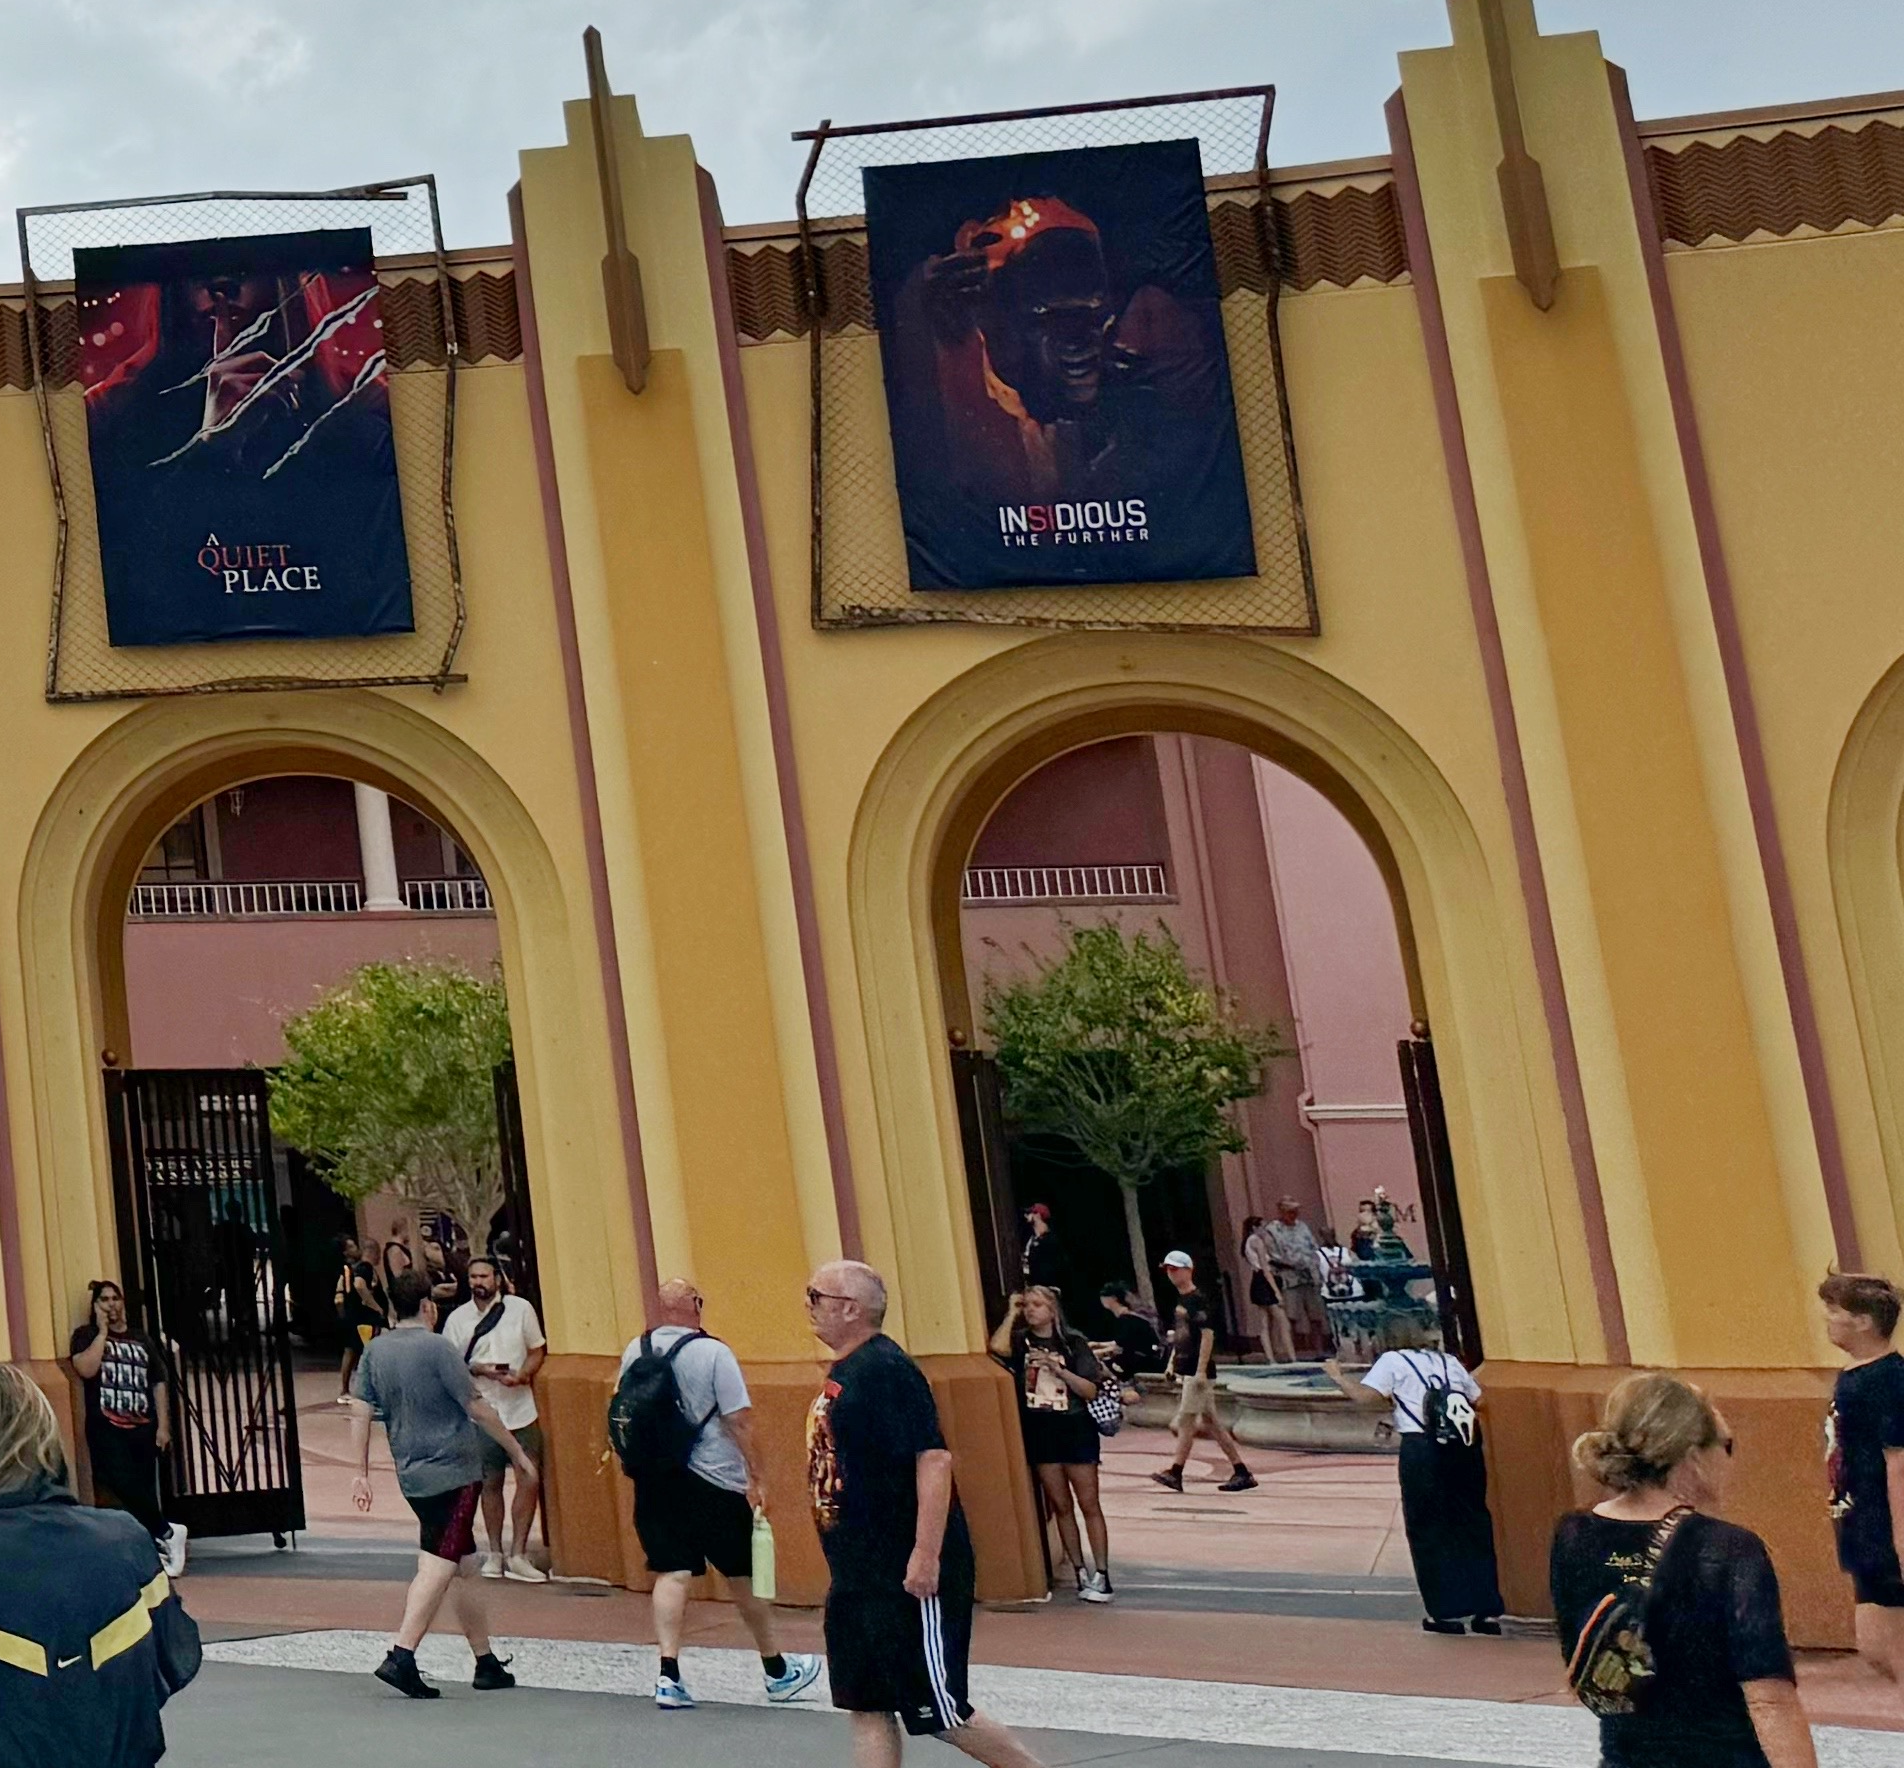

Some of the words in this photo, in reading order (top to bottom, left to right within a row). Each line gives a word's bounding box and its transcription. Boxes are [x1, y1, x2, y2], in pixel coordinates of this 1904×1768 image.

[999, 499, 1147, 533] INSIDIOUS
[206, 533, 219, 546] A
[1003, 534, 1039, 547] THE
[1055, 528, 1149, 544] FURTHER
[197, 544, 291, 575] QUIET
[223, 566, 321, 593] PLACE
